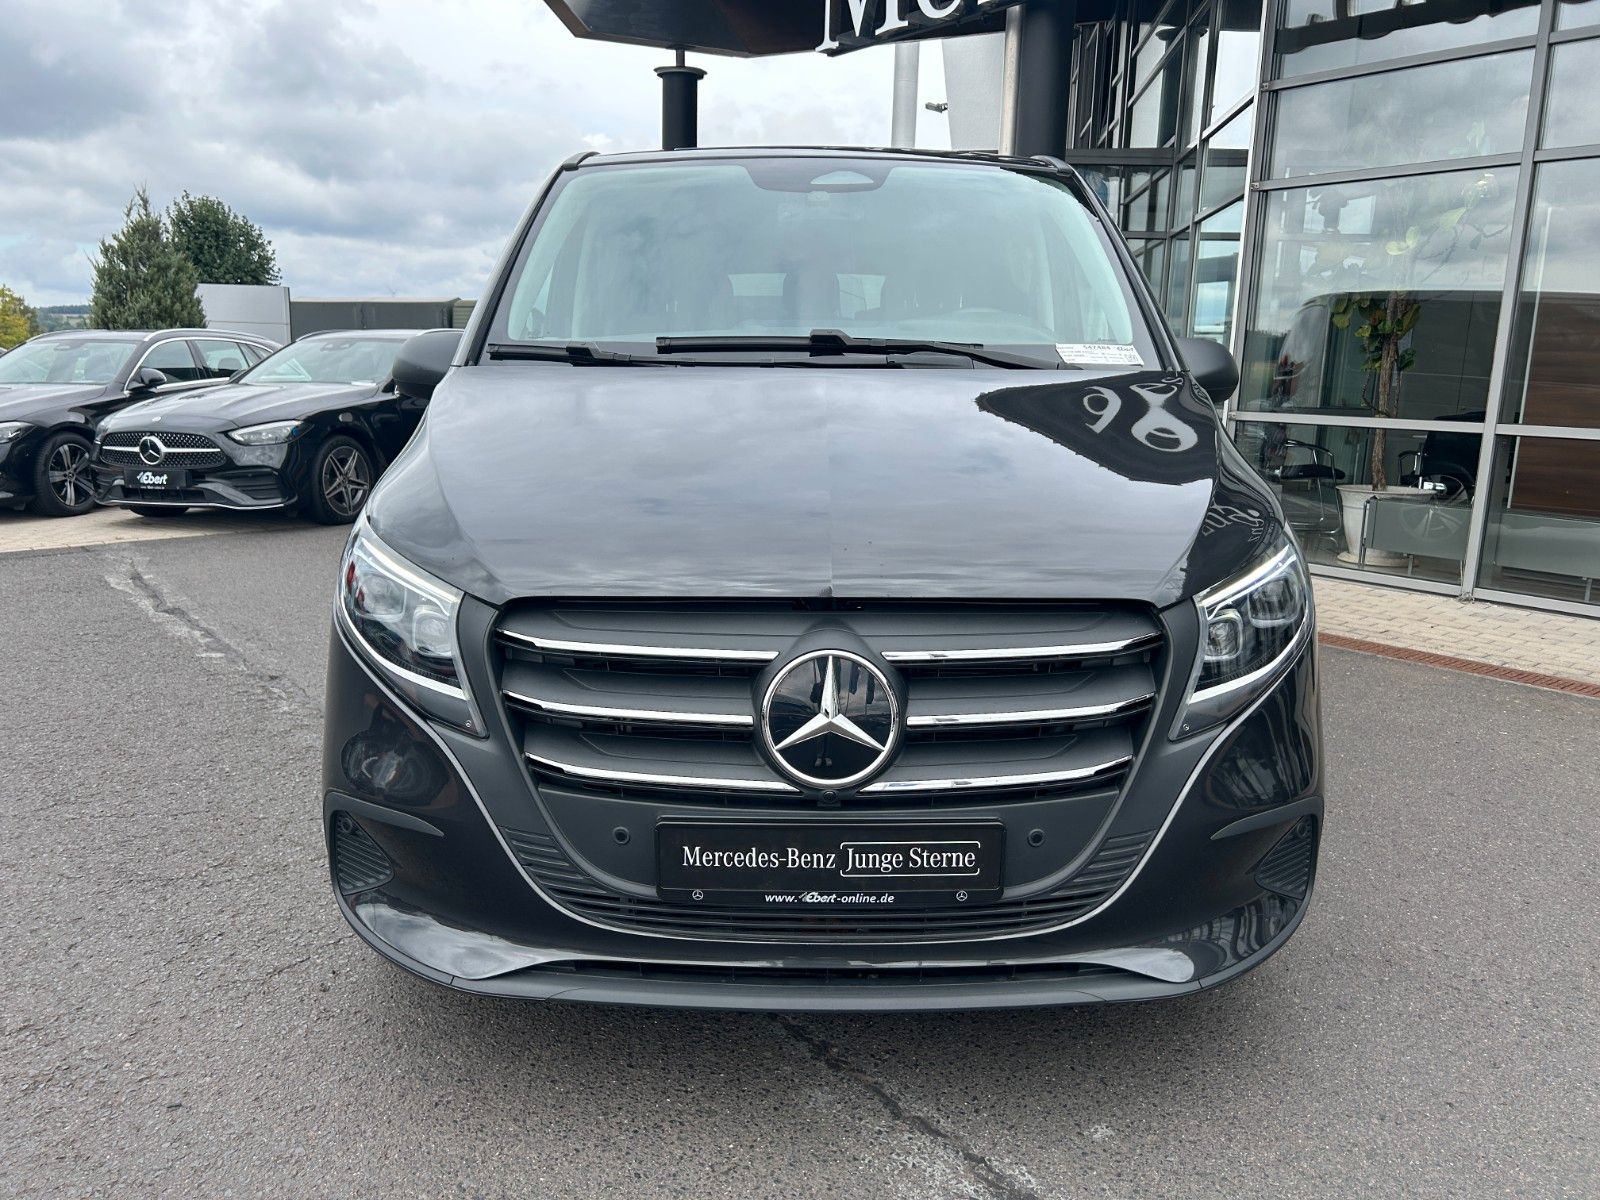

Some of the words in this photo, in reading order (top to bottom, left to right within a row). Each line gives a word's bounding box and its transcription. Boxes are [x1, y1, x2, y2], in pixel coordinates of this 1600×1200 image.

[140, 471, 168, 485] Ebert
[682, 845, 836, 869] Mercedes-Benz
[845, 848, 903, 873] Junge
[908, 847, 976, 868] Sterne
